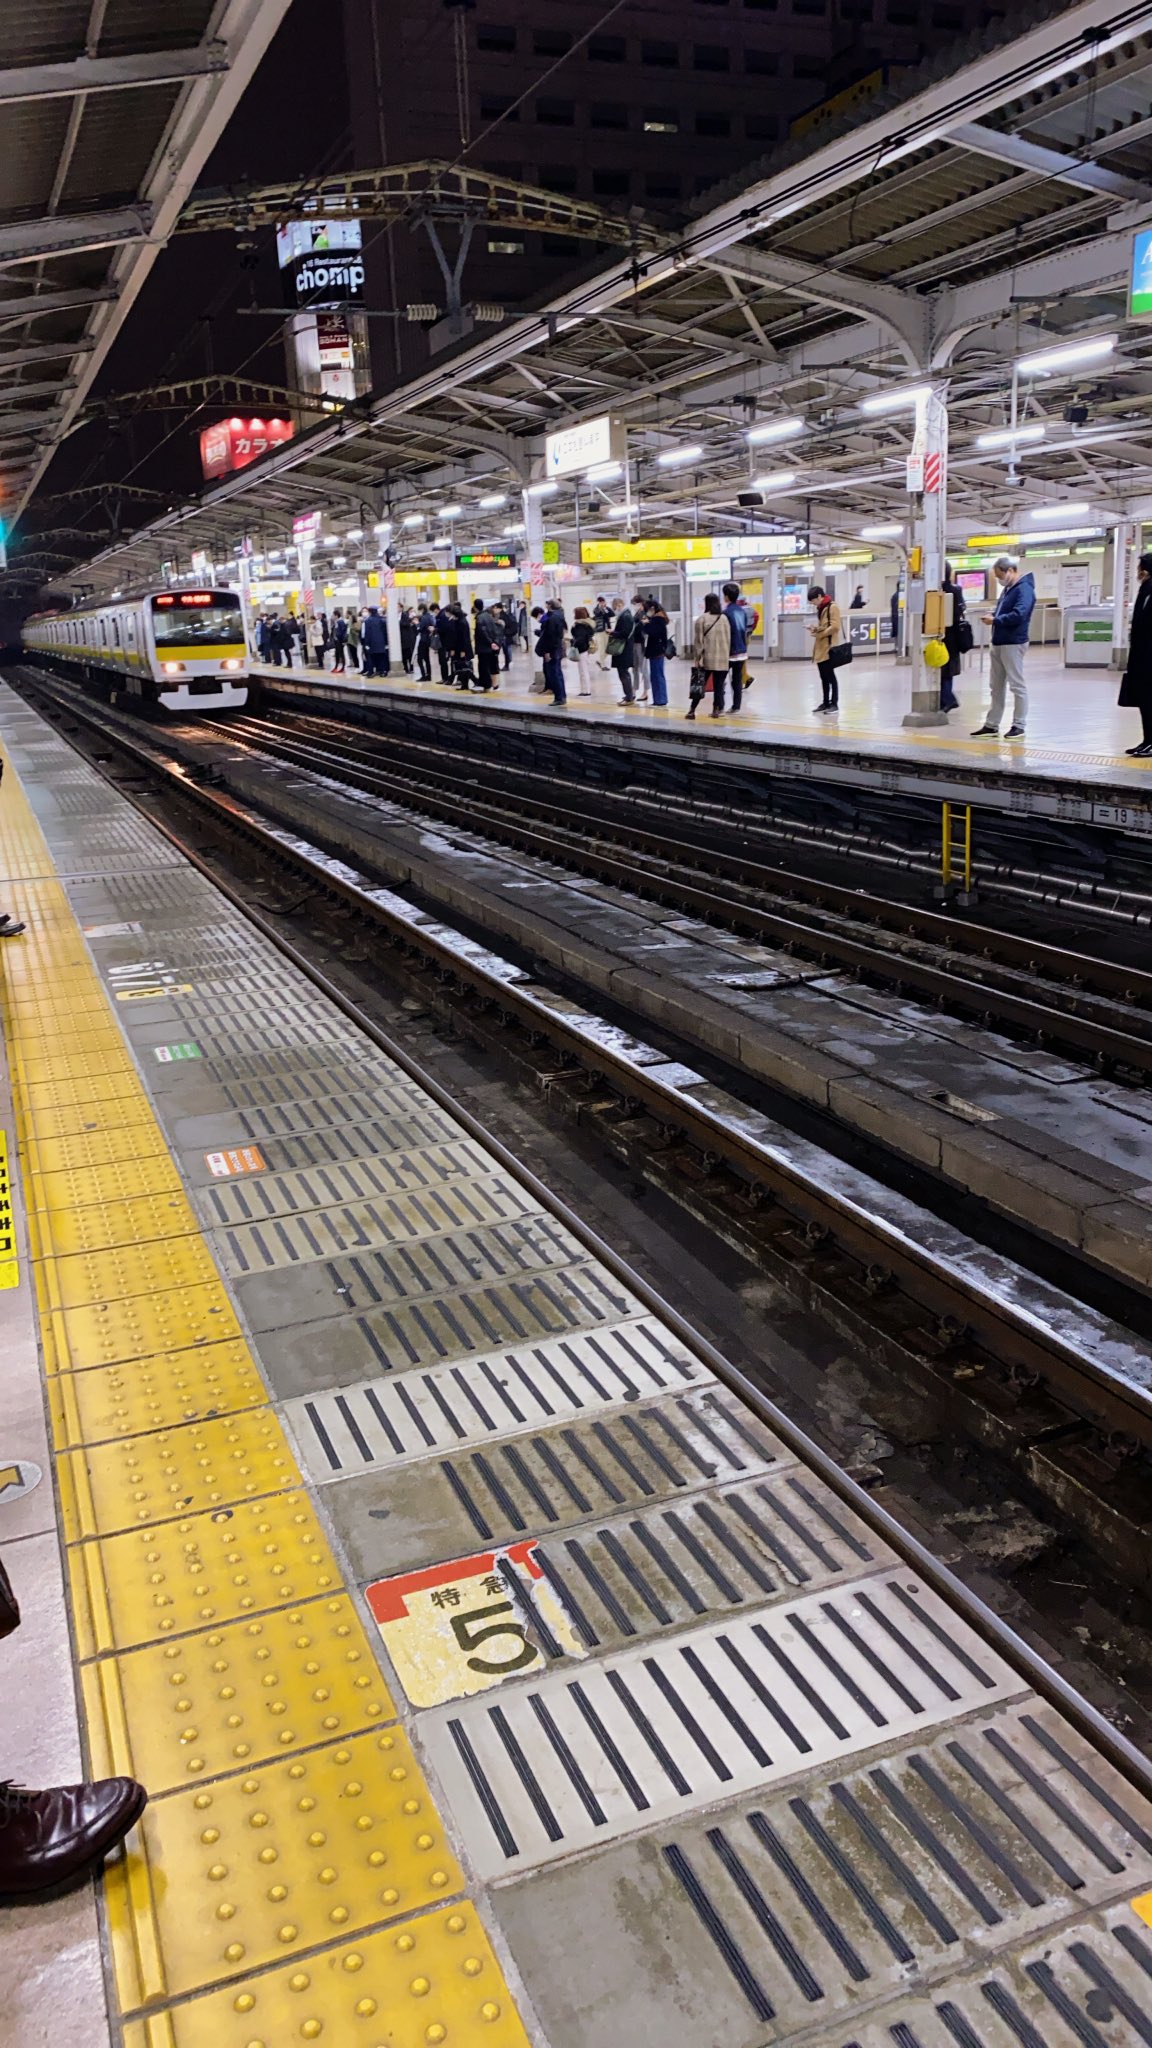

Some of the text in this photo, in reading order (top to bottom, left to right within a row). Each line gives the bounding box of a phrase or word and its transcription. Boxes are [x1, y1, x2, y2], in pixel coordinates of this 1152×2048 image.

[859, 623, 869, 640] 5
[1114, 808, 1127, 823] 19
[430, 1574, 508, 1609] 特急
[450, 1600, 538, 1674] 5
